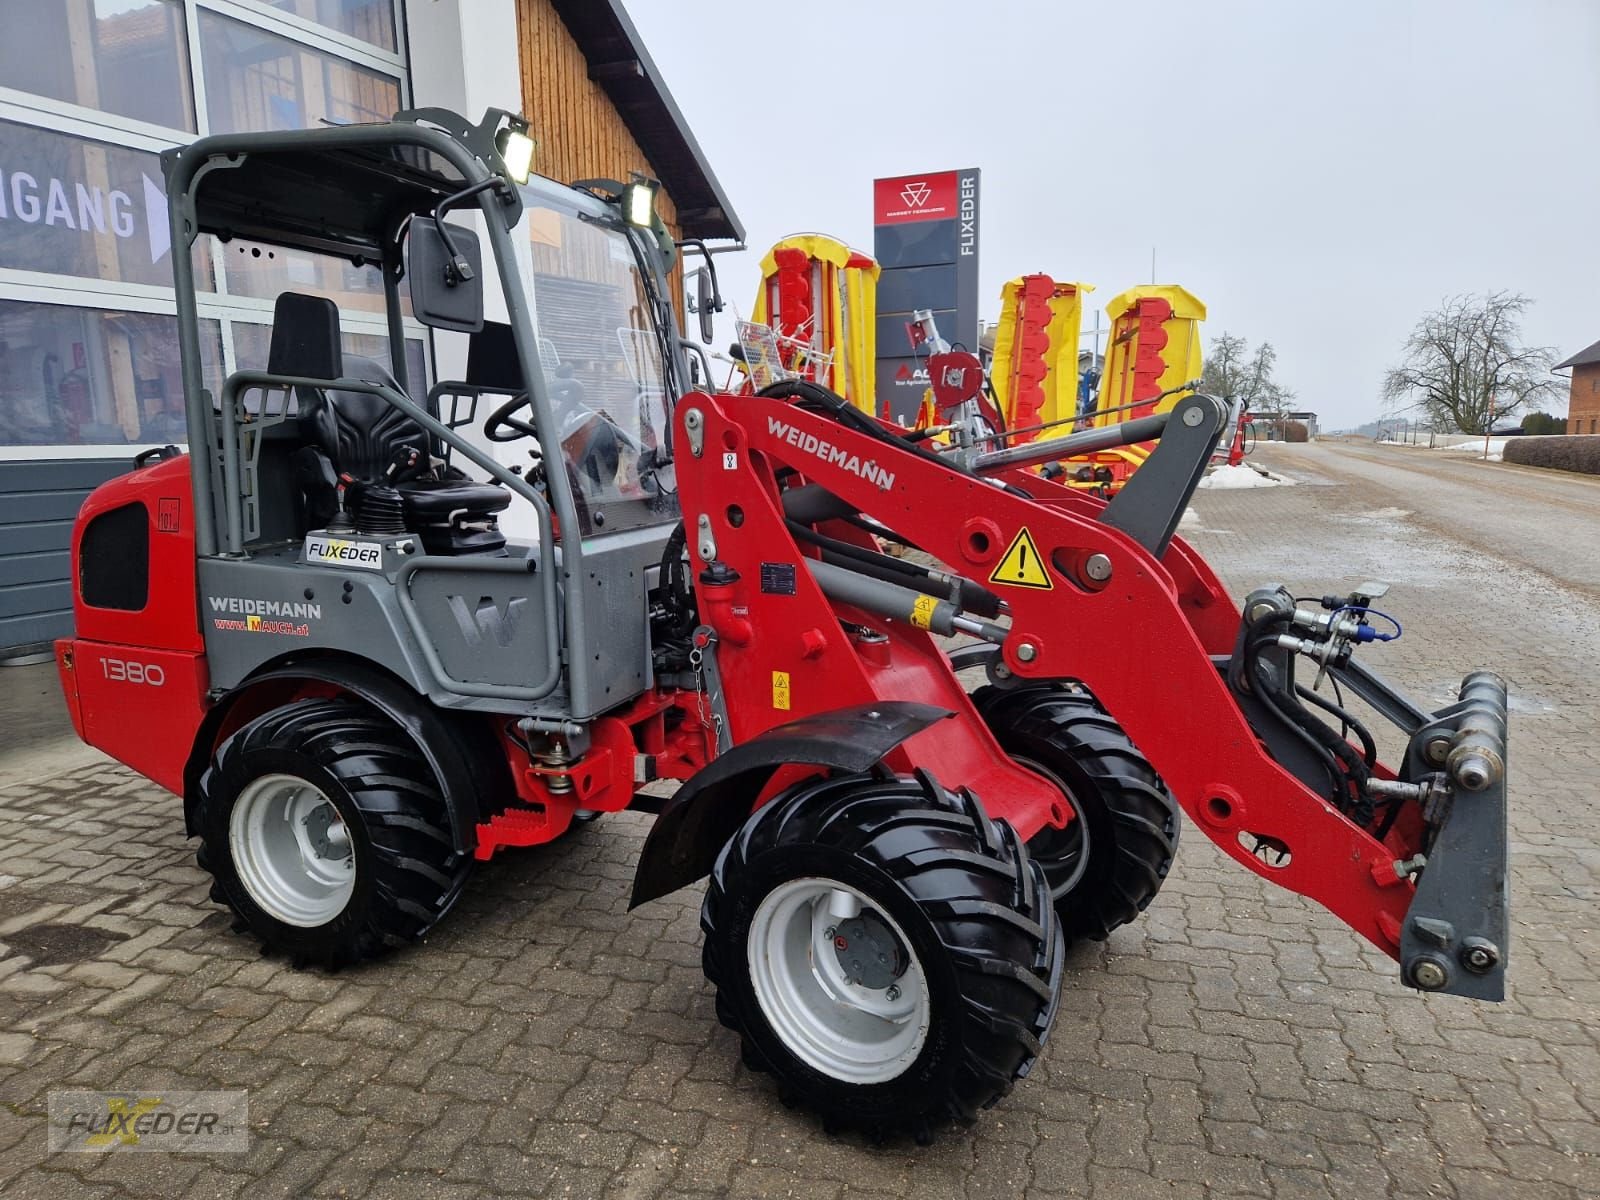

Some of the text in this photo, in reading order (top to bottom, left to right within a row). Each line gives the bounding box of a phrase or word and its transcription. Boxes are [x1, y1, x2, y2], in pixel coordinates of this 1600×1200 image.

[0, 167, 135, 238] GANG
[961, 177, 975, 256] FLIXEDER
[767, 415, 895, 491] WEIDEMANN
[309, 543, 379, 563] FLIXEDER
[208, 596, 321, 620] WEIDEMANN
[99, 657, 165, 687] 1380
